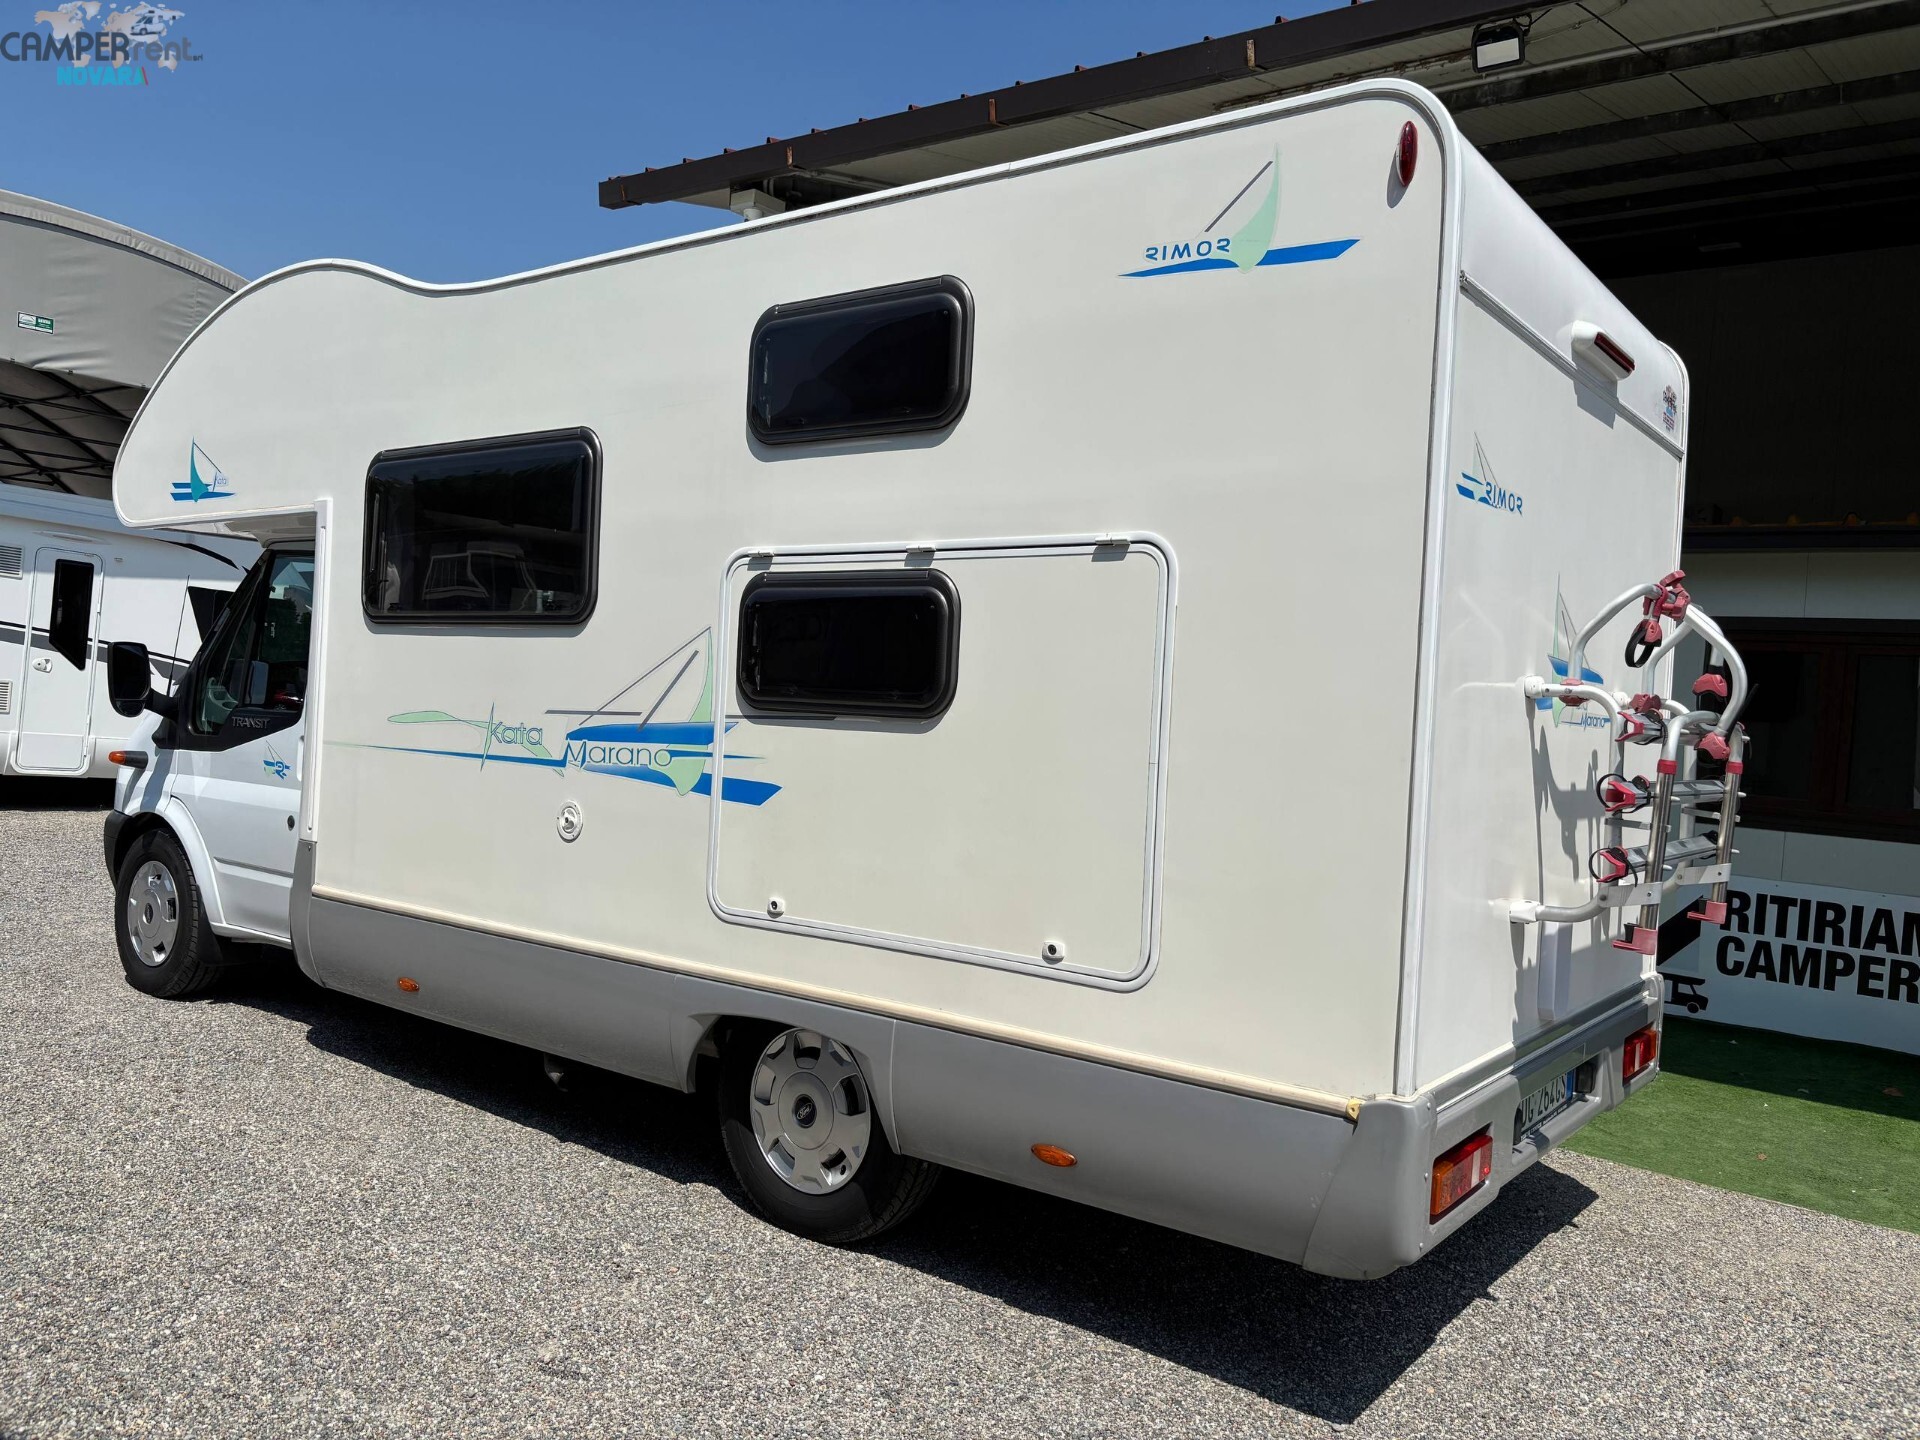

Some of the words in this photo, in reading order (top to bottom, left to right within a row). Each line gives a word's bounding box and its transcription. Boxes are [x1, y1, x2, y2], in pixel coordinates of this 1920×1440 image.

[1144, 238, 1231, 262] RIMOR
[1485, 481, 1524, 518] RIMOR
[231, 716, 271, 730] TRANSIT
[562, 740, 673, 769] Marano
[1716, 936, 1920, 1004] CAMPER
